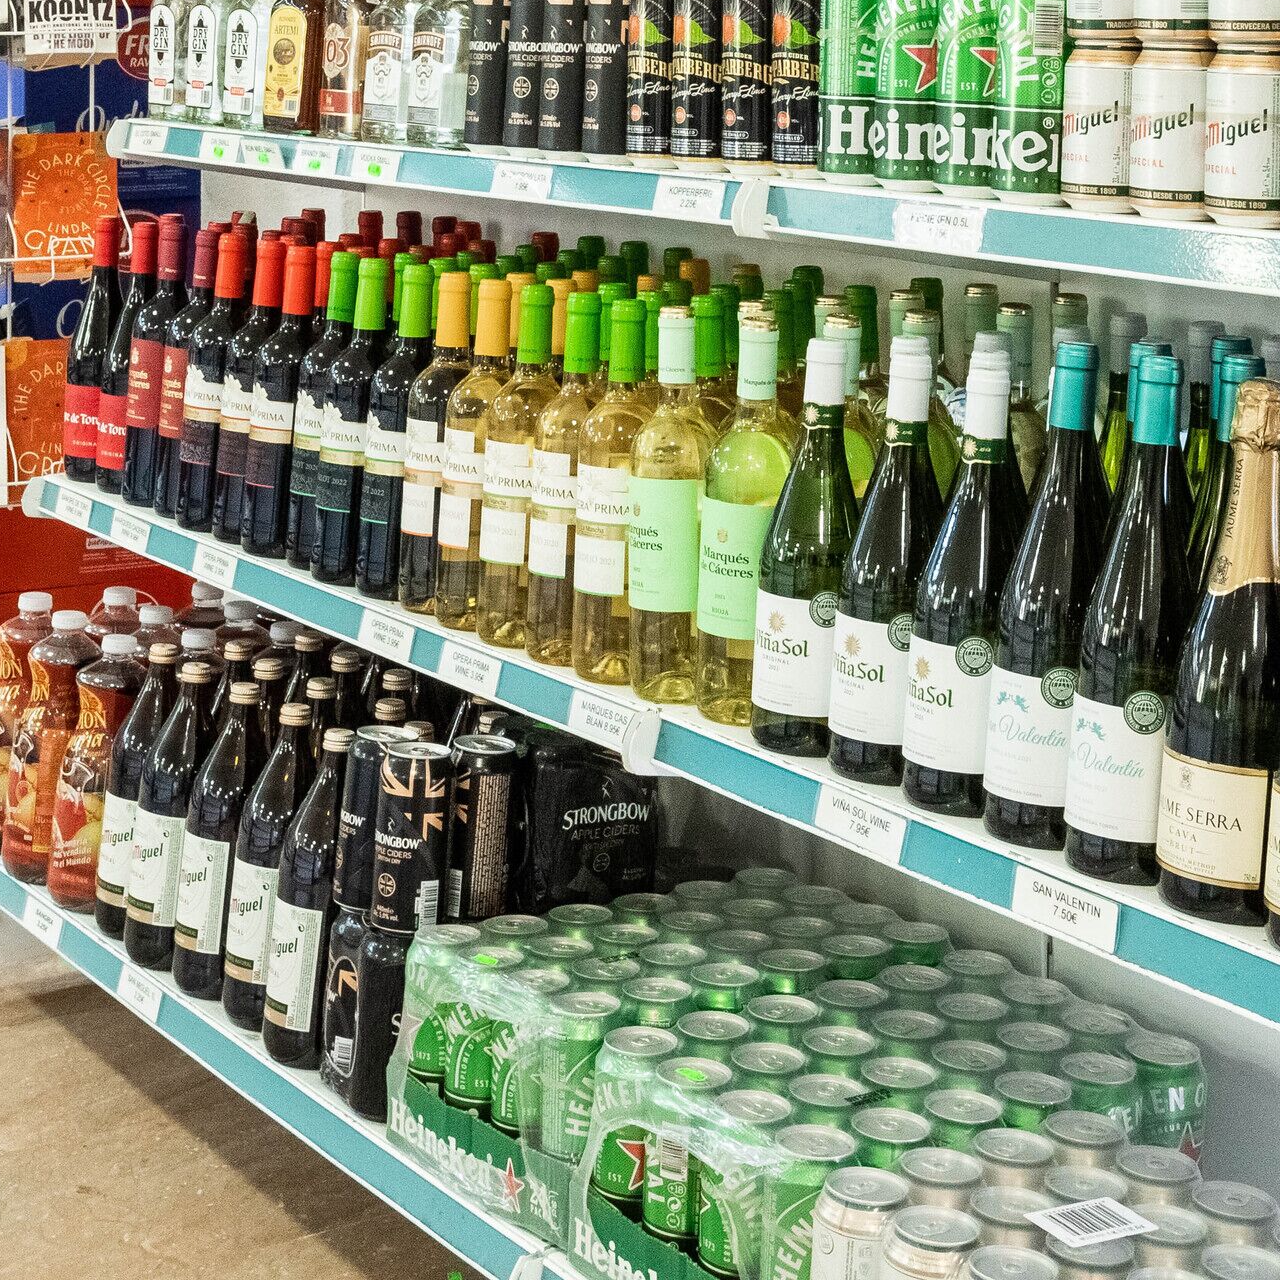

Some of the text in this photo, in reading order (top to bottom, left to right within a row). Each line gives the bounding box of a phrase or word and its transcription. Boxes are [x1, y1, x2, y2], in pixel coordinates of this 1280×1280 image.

[153, 27, 168, 37] DRY
[153, 37, 168, 48] GIN
[39, 153, 83, 171] DARK
[48, 222, 90, 234] LINDA
[331, 431, 361, 444] PRIMA
[703, 546, 750, 565] Marqués
[708, 562, 754, 580] Cáceres
[582, 701, 628, 725] MARQUES CAS
[1076, 742, 1145, 778] Valentín
[562, 802, 649, 830] STRONGBOW
[852, 806, 867, 822] SOL
[870, 813, 890, 832] WINE
[1187, 810, 1242, 832] SERRA
[571, 824, 638, 840] APPLE CIDERS
[1032, 880, 1100, 918] SAN VALENTIN
[1054, 905, 1077, 924] 7.50€
